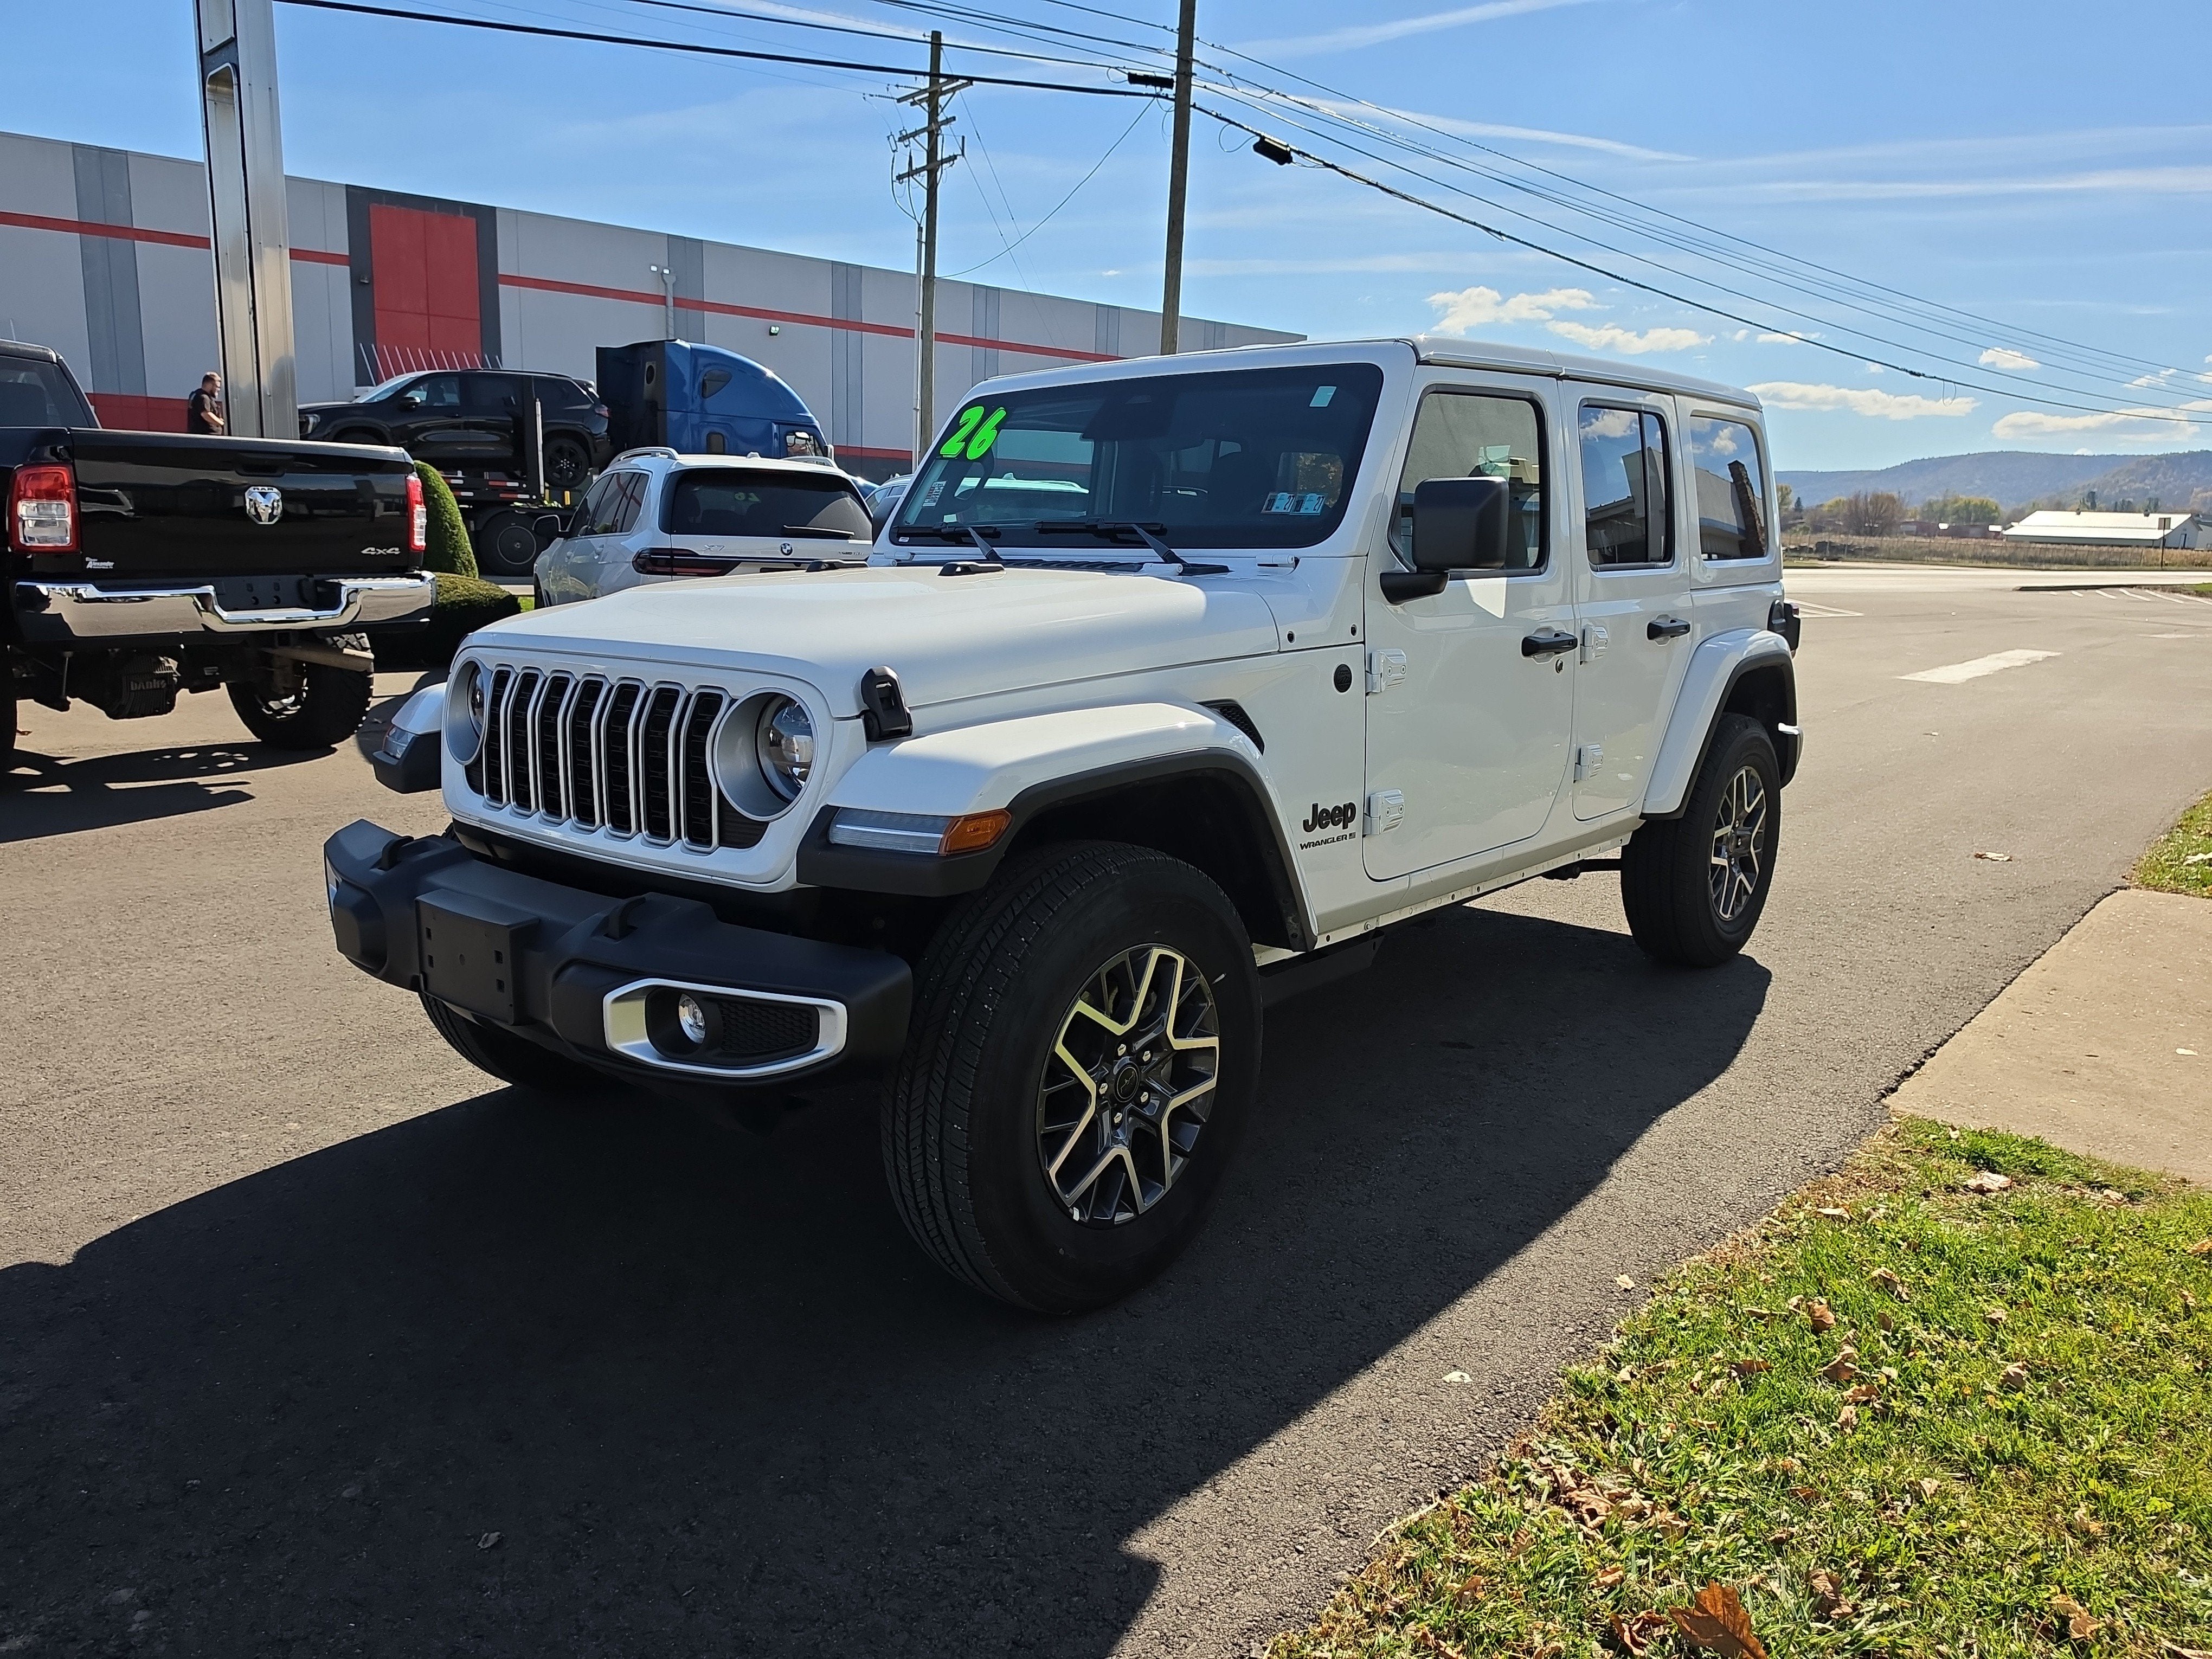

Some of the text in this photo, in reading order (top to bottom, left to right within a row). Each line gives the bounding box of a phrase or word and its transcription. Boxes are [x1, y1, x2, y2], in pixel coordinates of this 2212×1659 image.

[940, 406, 1006, 460] 26
[1283, 495, 1295, 511] 27
[1313, 496, 1325, 512] 27
[360, 546, 401, 555] 4x4
[1303, 802, 1356, 833] Jeep
[1300, 834, 1348, 851] WRANGLER
